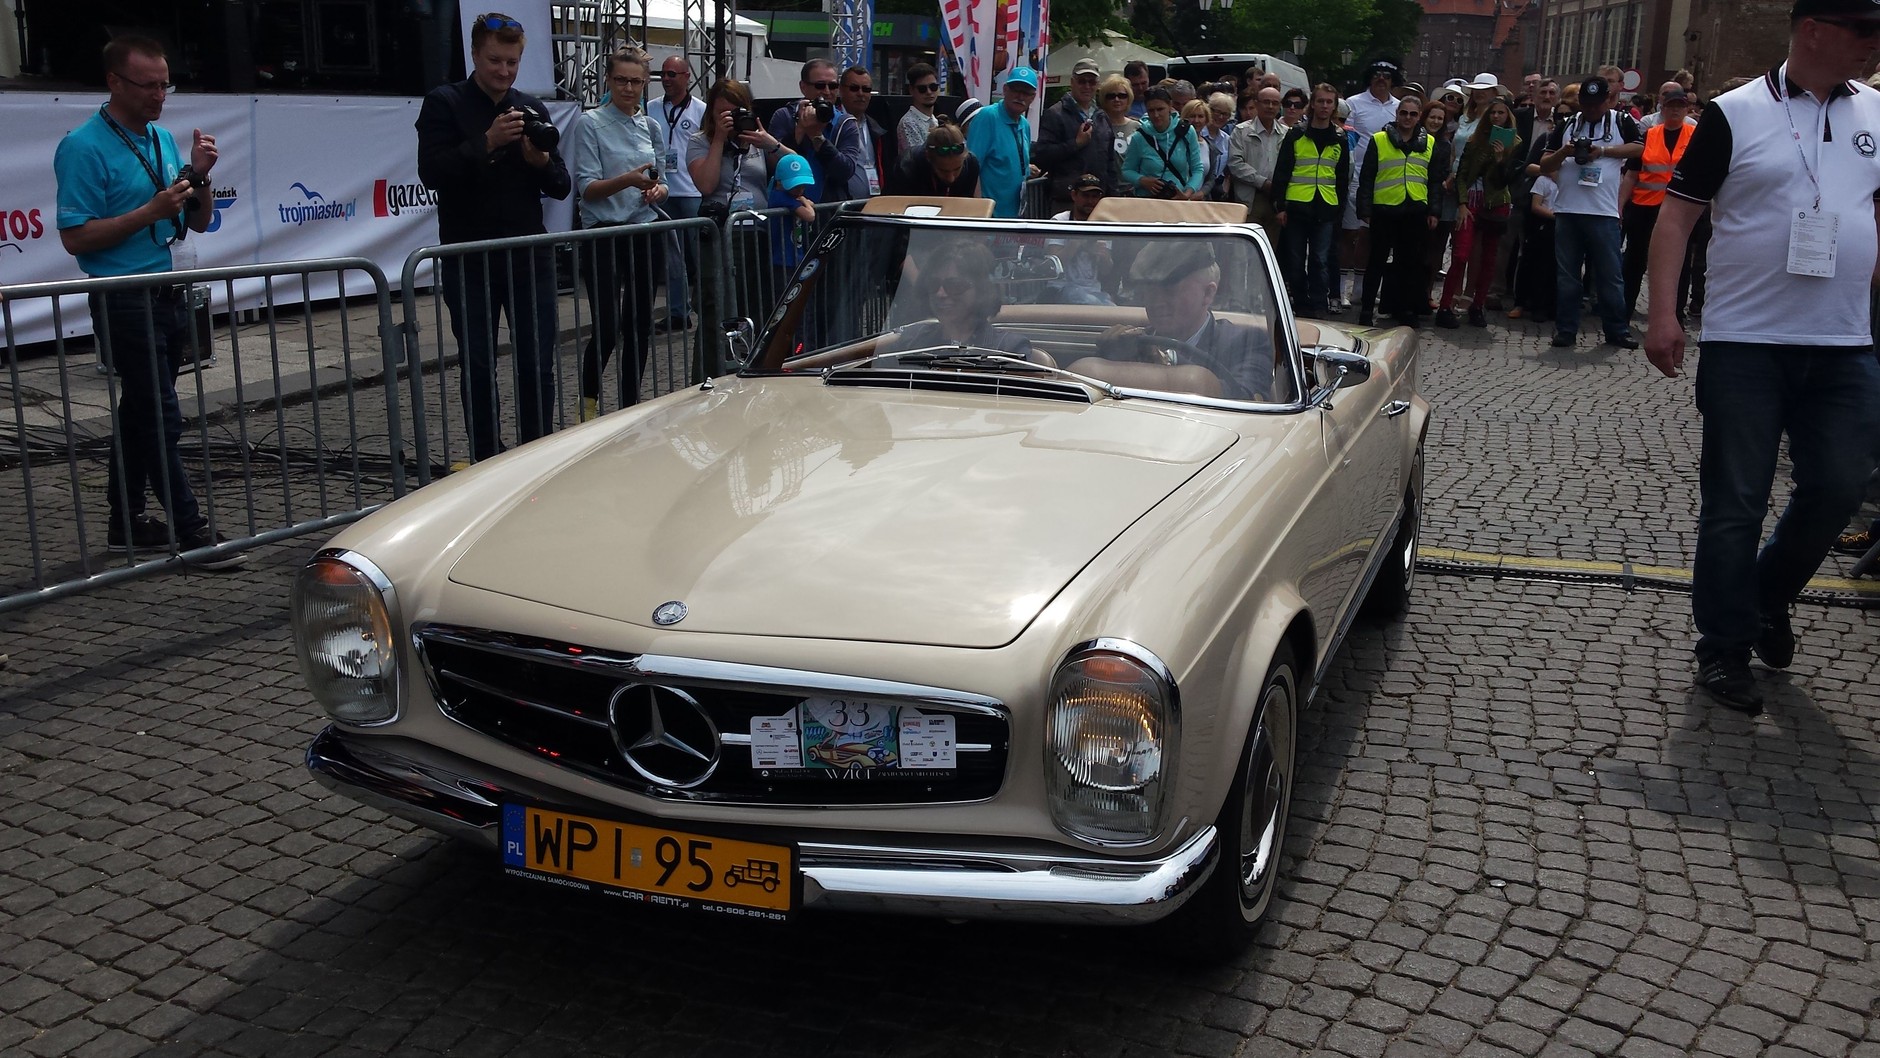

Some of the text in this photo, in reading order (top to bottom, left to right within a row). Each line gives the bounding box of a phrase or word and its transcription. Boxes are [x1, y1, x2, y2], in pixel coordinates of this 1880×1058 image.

[278, 198, 356, 226] trojmiasto.pl
[507, 840, 523, 856] PL
[655, 835, 713, 892] 95
[505, 868, 590, 891] WYPOŻYCZALNIA SAMOCHODOWA
